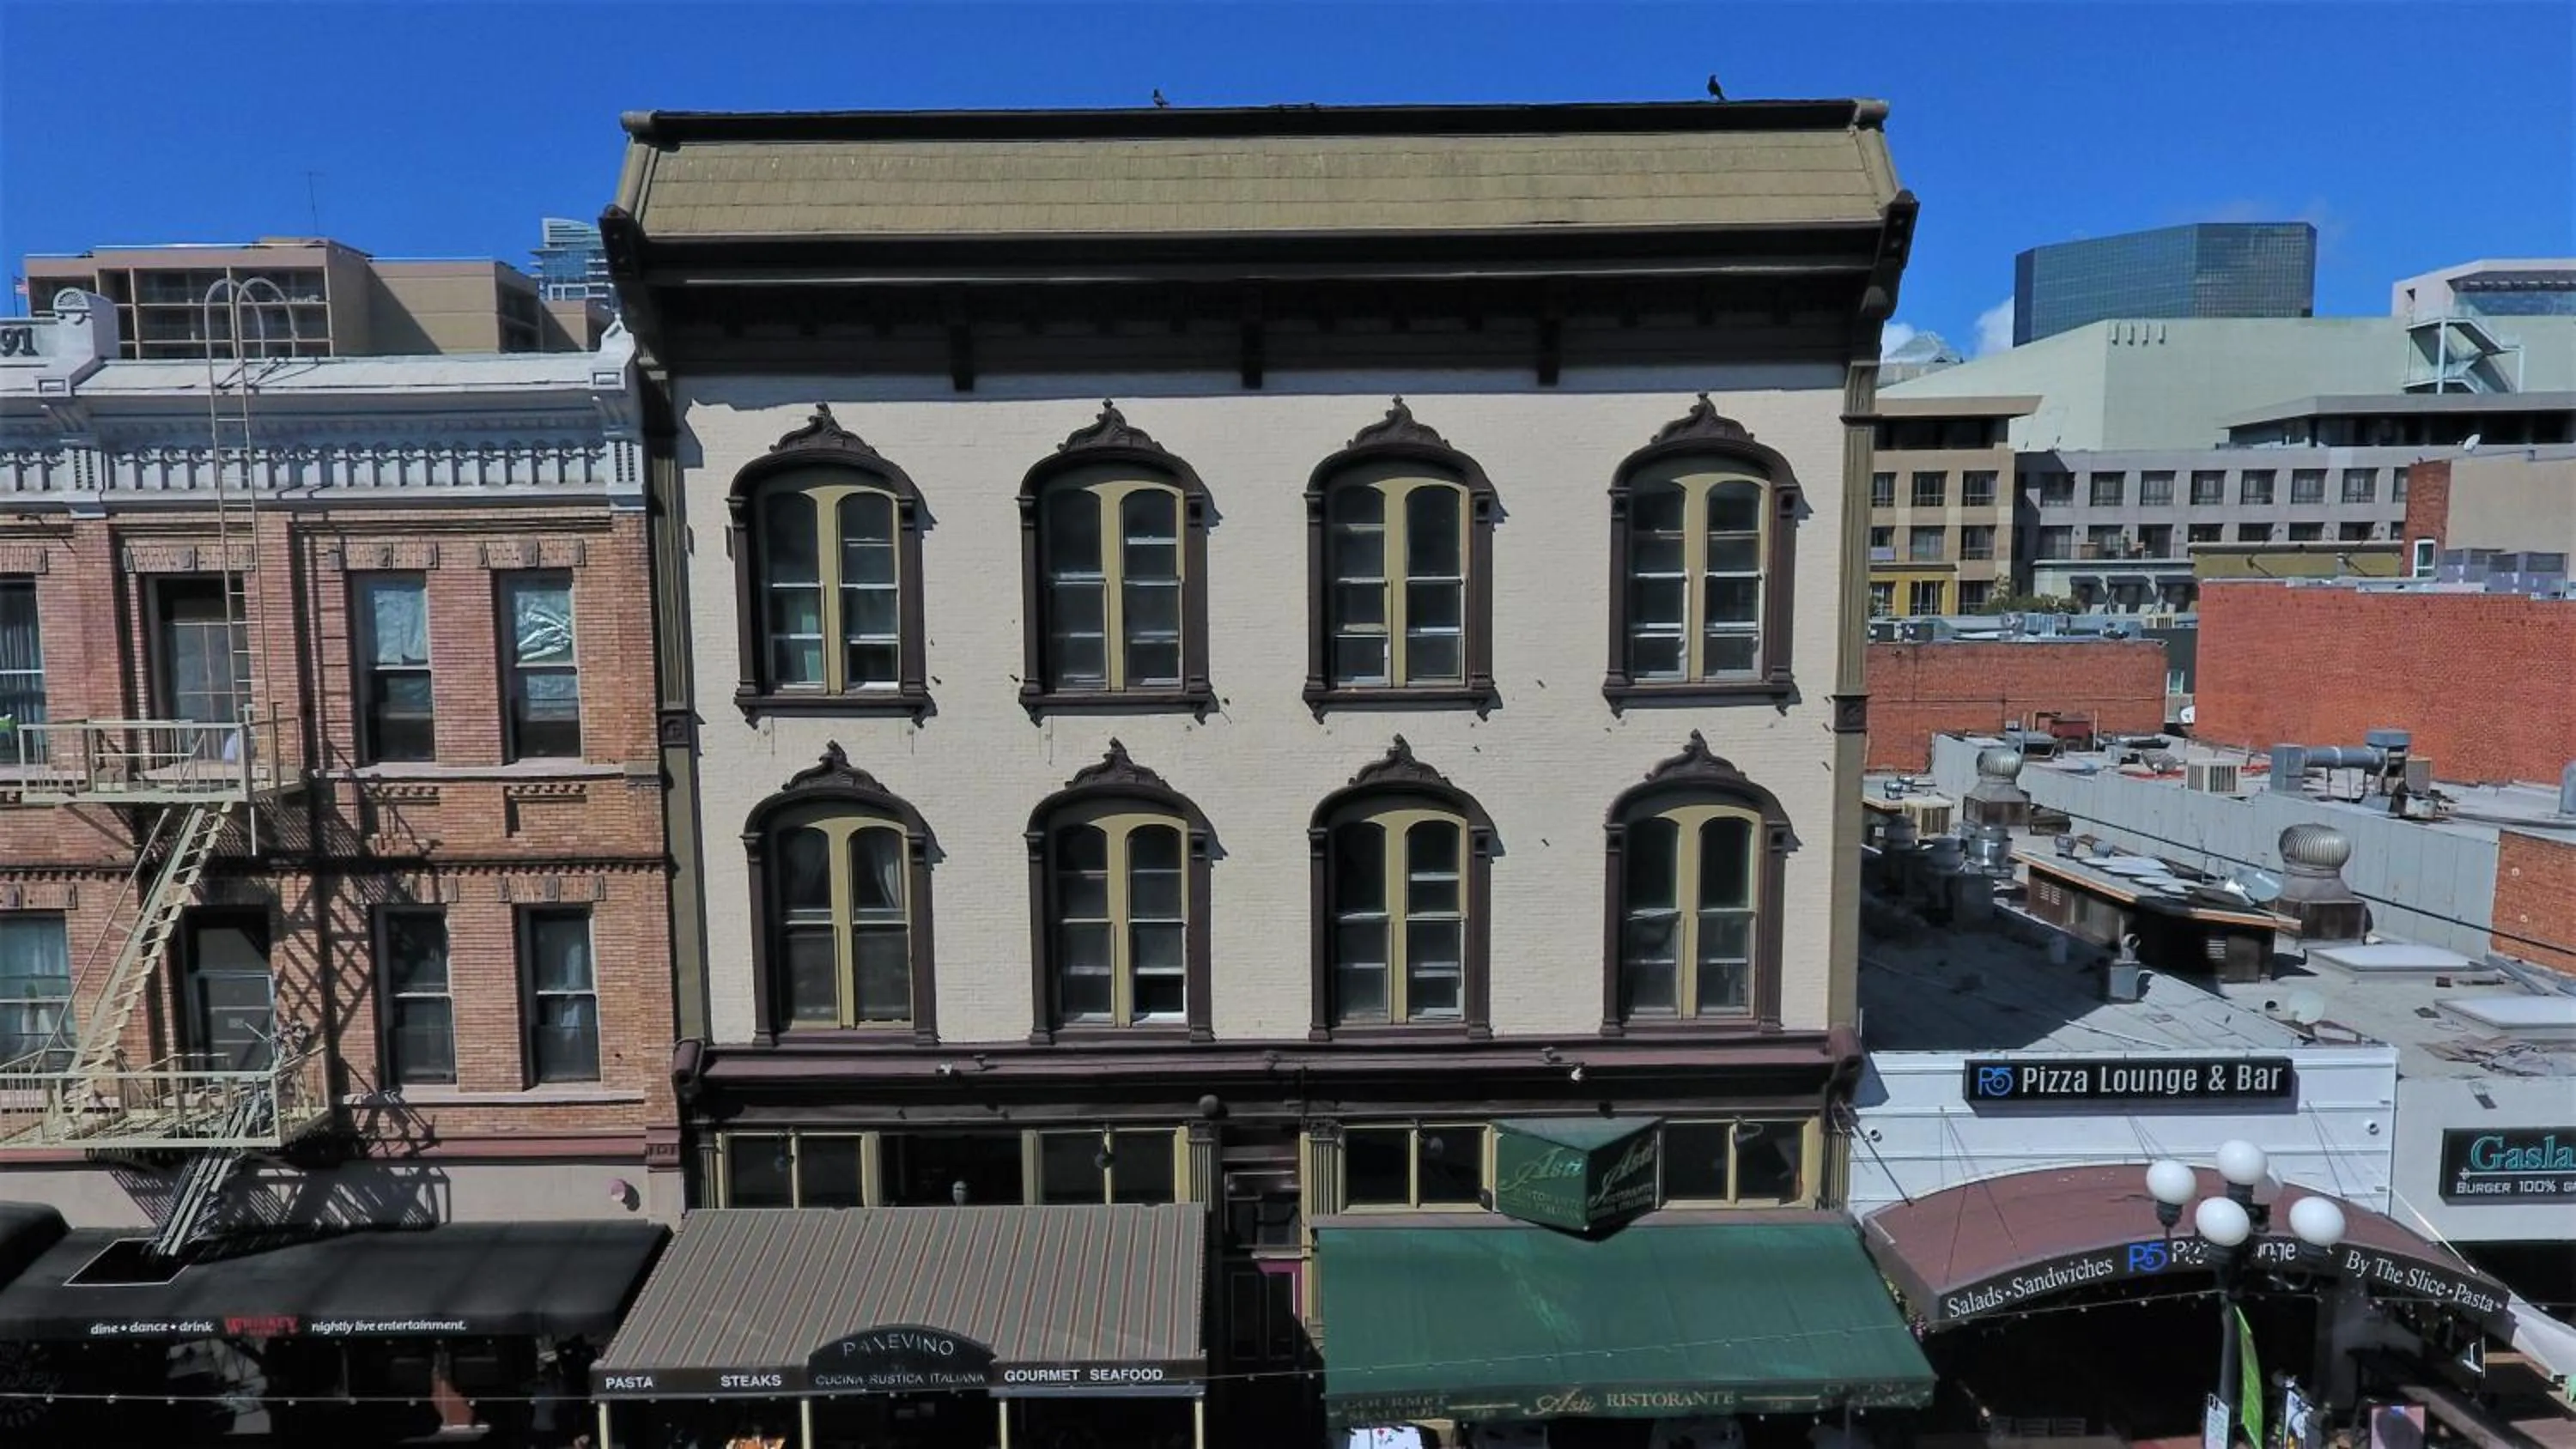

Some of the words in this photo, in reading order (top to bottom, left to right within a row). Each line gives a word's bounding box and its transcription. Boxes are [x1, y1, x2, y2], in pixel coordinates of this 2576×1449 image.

[2021, 1065, 2088, 1093] Pizza
[2099, 1065, 2197, 1094] Lounge
[2208, 1064, 2227, 1091] &
[2237, 1064, 2283, 1091] Bar
[2456, 1181, 2512, 1194] BURGER
[2519, 1179, 2556, 1192] 100%
[1947, 1286, 2003, 1318] Salads
[2012, 1258, 2113, 1299] Sandwiches
[2346, 1249, 2371, 1278] By
[2375, 1258, 2404, 1284] The
[2406, 1267, 2446, 1297] Slice
[2453, 1282, 2494, 1313] Pasta
[90, 1323, 118, 1335] dine
[129, 1321, 168, 1333] dance
[179, 1321, 214, 1333] drink
[312, 1319, 354, 1335] nightly
[355, 1319, 375, 1331] live
[605, 1376, 653, 1389] PASTA
[720, 1374, 783, 1387] STEAKS
[816, 1373, 863, 1385] CUCINA
[869, 1374, 924, 1385] RUSTICA
[929, 1373, 985, 1384] ITALIANA
[1004, 1369, 1081, 1382] GOURMET
[1089, 1367, 1164, 1381] SEAFOOD
[1606, 1390, 1735, 1409] RISTORANTE
